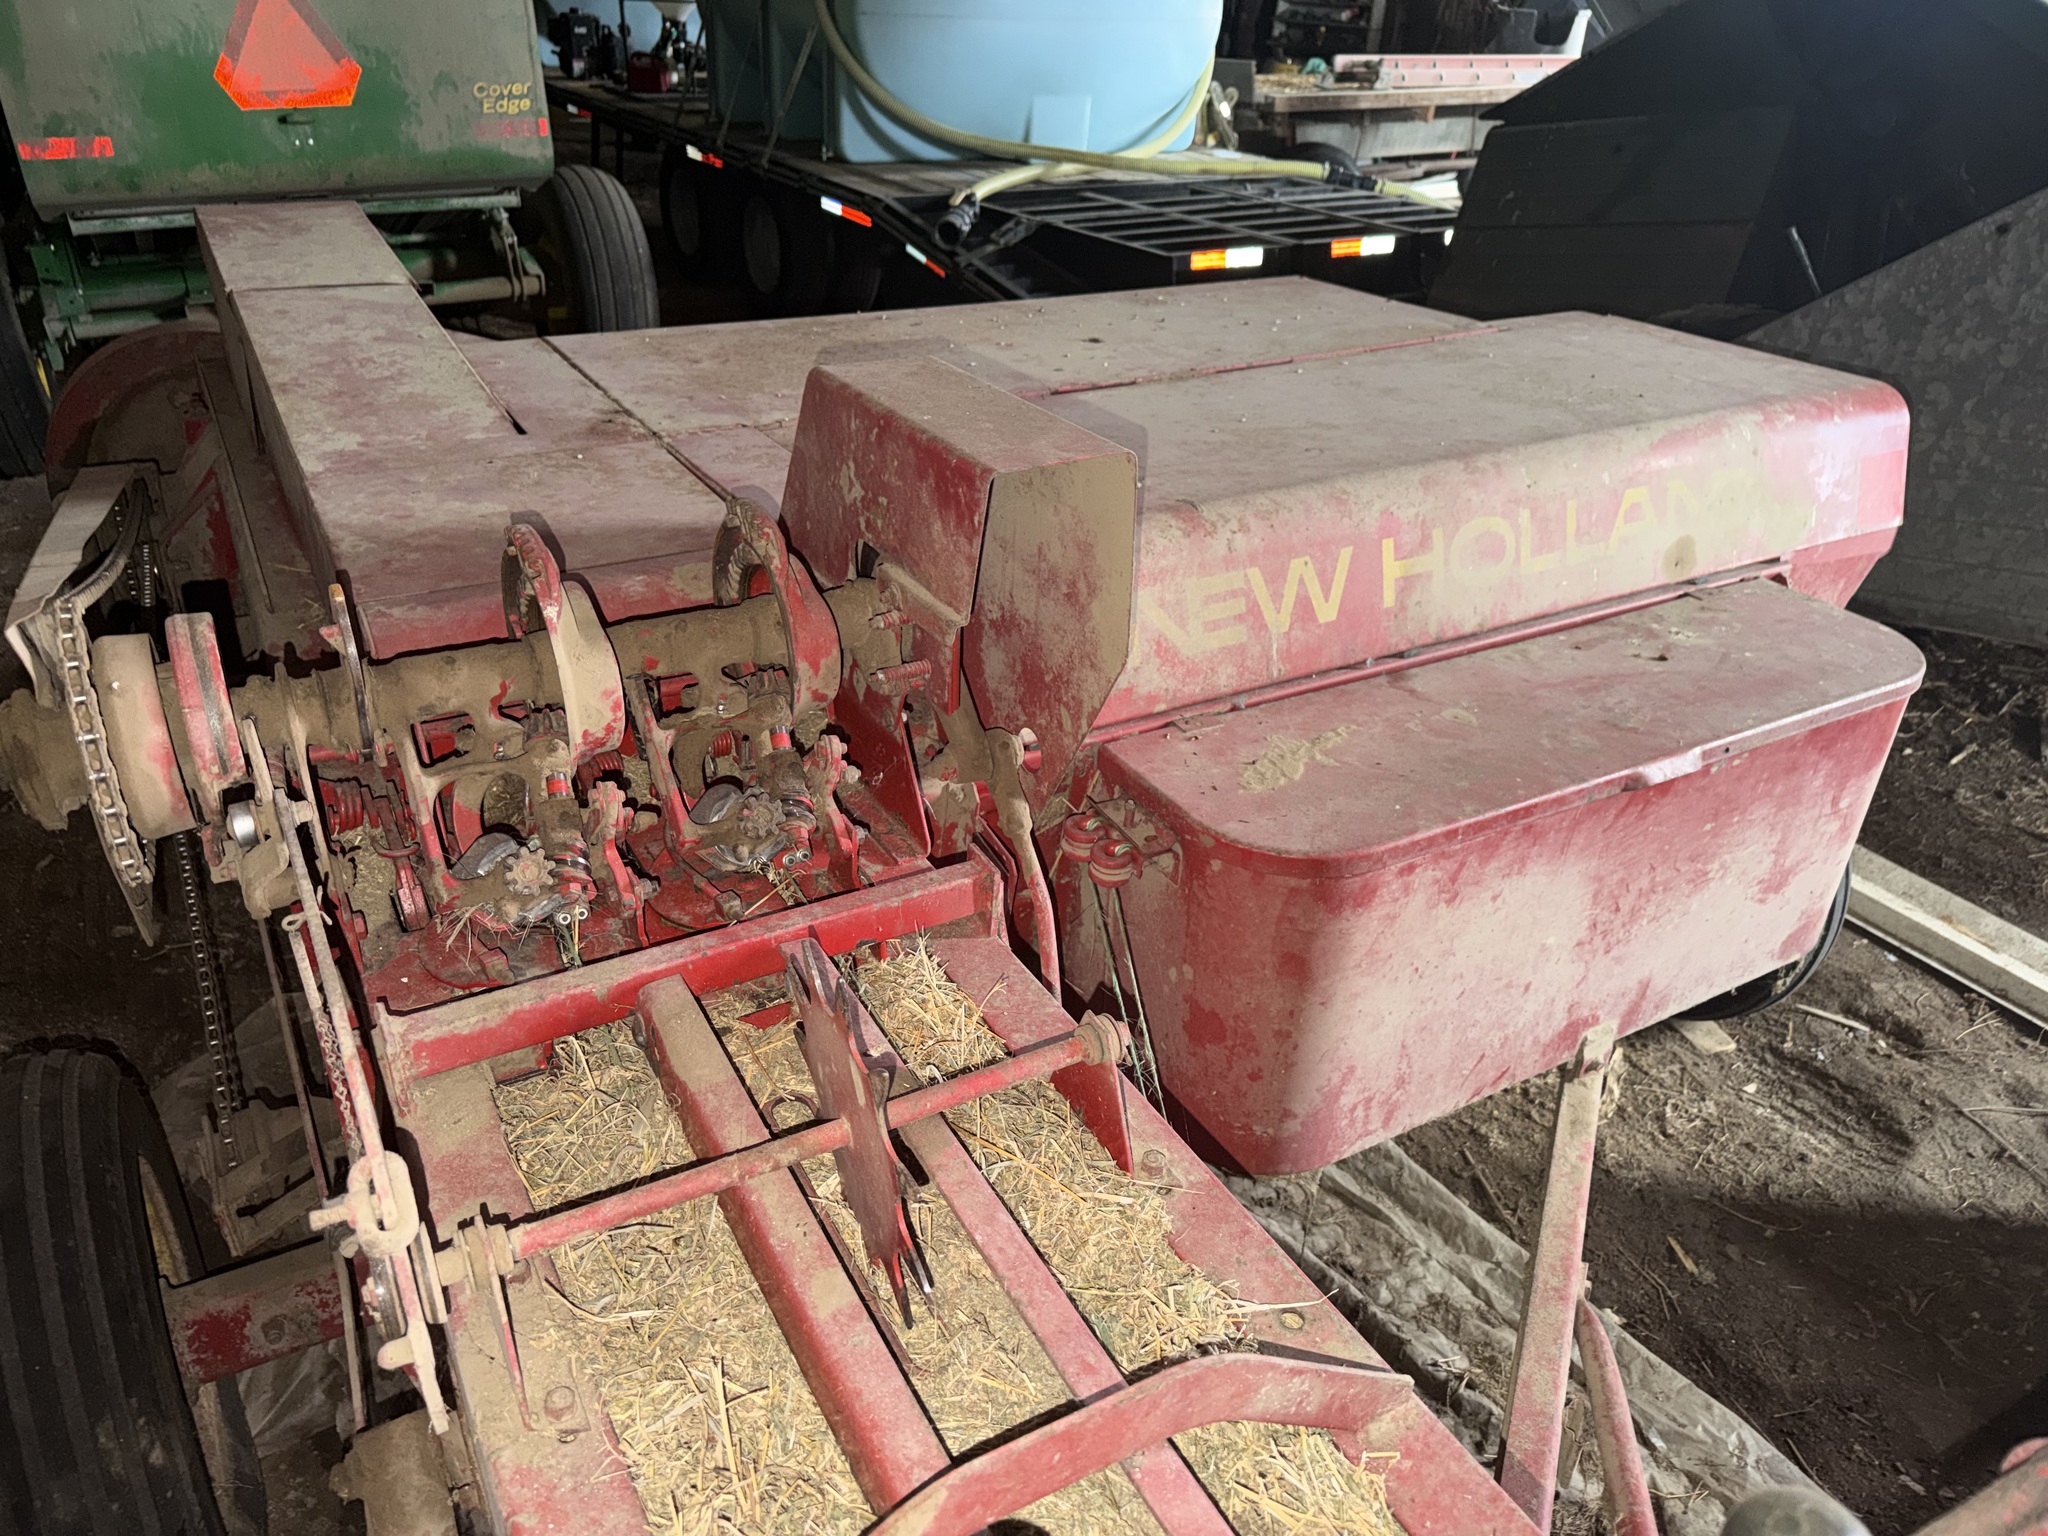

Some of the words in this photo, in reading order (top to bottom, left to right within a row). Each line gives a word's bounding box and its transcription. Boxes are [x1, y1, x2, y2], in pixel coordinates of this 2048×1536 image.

[473, 81, 532, 98] Cover
[483, 96, 531, 115] Edge
[1382, 470, 1755, 608] HOLLAN
